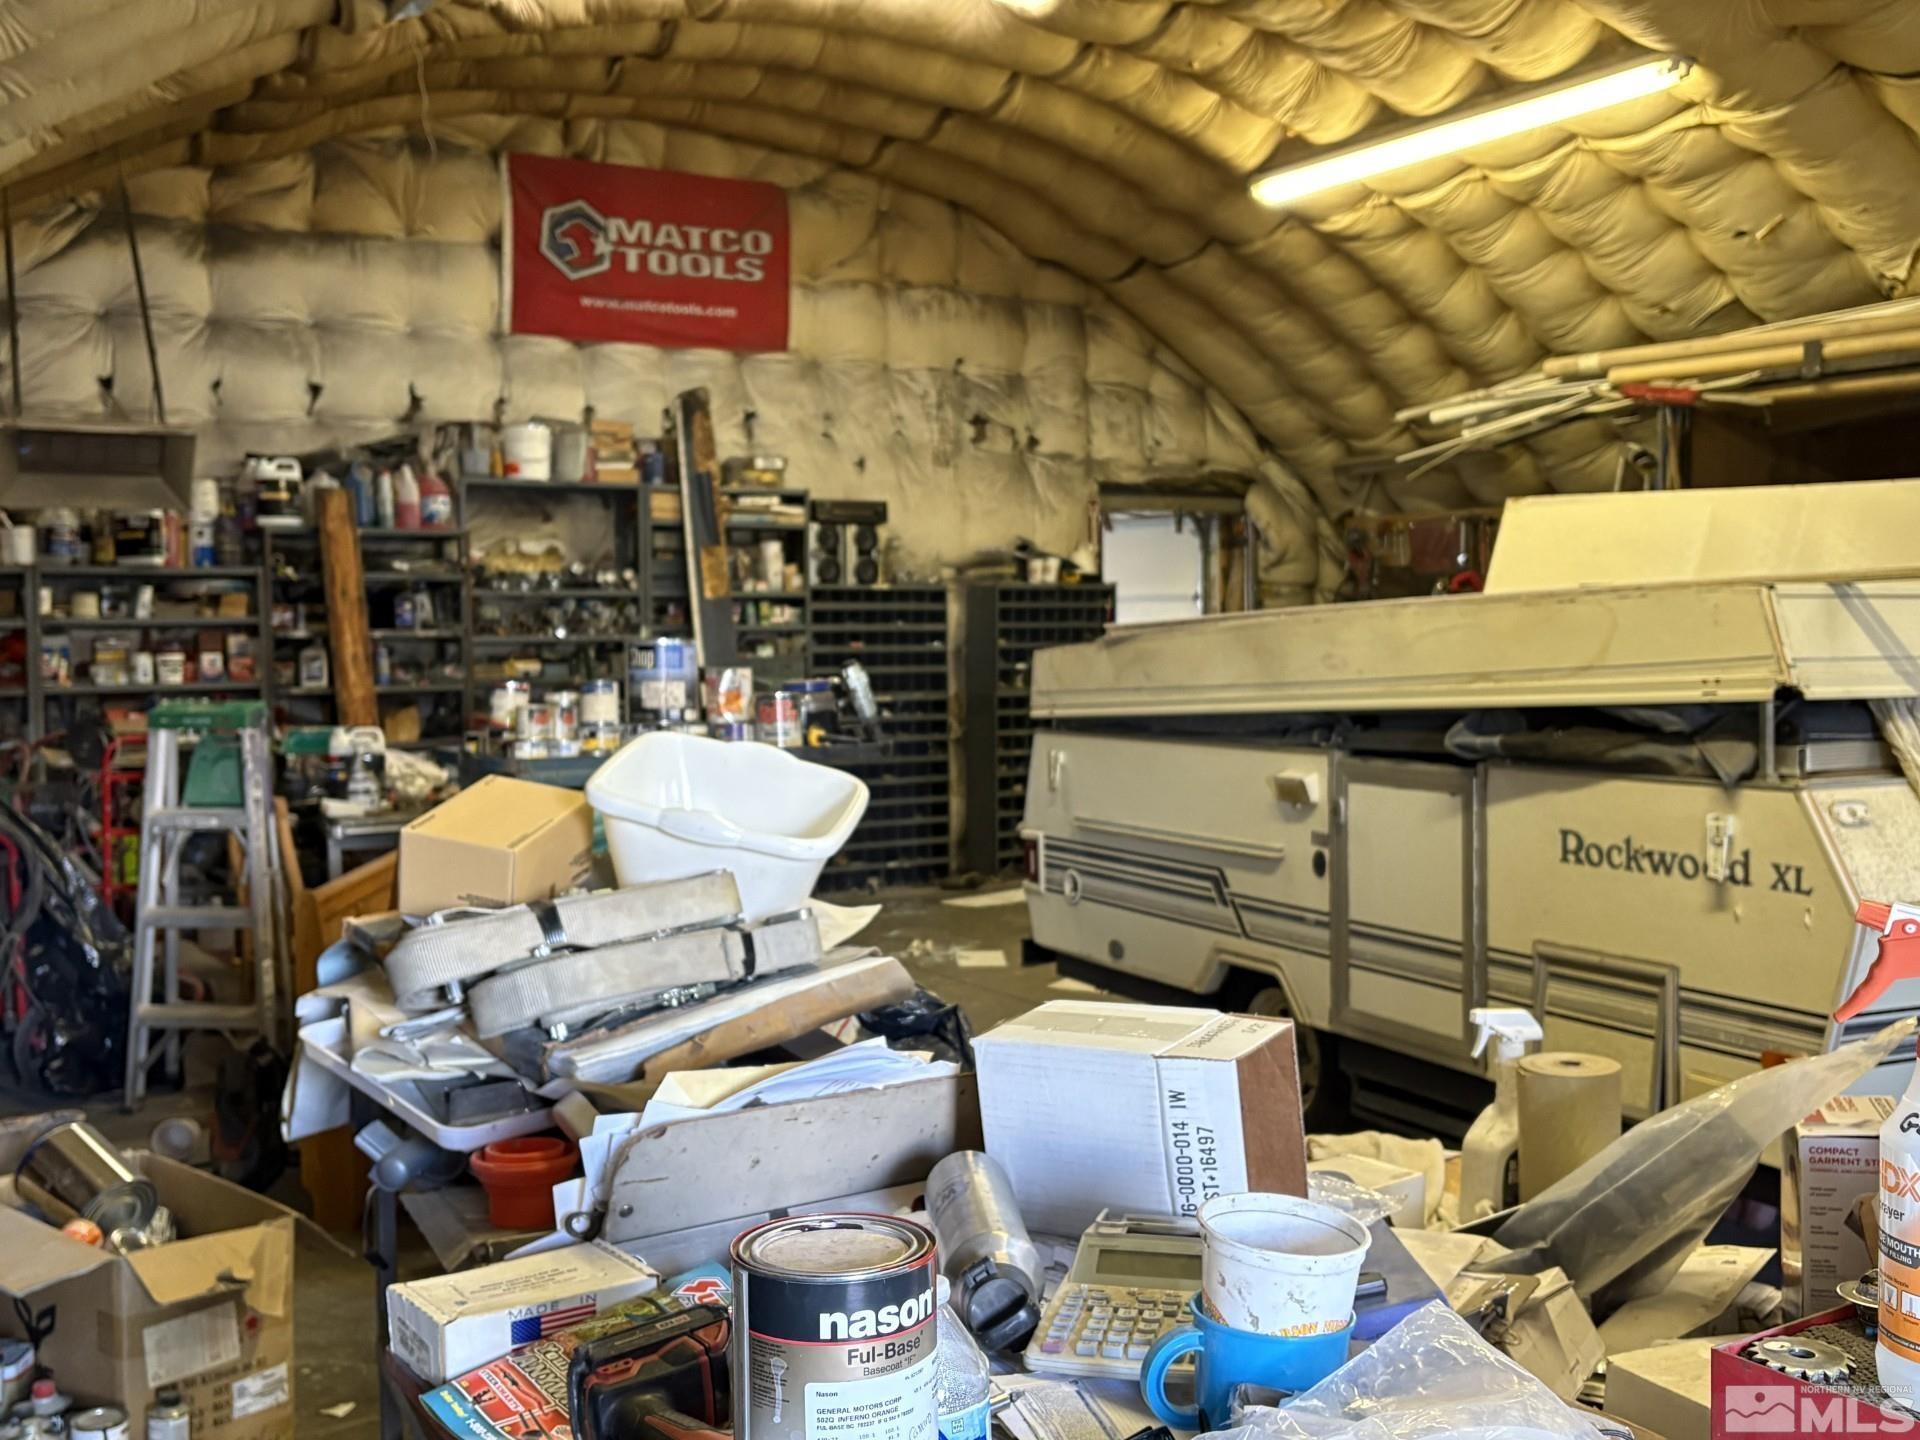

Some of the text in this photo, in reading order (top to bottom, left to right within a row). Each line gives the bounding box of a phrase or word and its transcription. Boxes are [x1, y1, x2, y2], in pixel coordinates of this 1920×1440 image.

[605, 216, 773, 255] MATCO
[616, 247, 765, 282] TOOLS
[1559, 828, 1813, 896] Rockwod XL
[1809, 1146, 1859, 1157] COMPACT
[1809, 1156, 1861, 1167] GARMENT
[1880, 1157, 1920, 1204] DX
[1887, 1233, 1920, 1259] MOUTH
[508, 1293, 597, 1320] MADE IN
[820, 1288, 933, 1340] nason
[847, 1335, 921, 1366] Ful-Base
[863, 1360, 903, 1377] Basecoat
[816, 1396, 902, 1415] GENERAL MOTORS CORP
[837, 1413, 870, 1423] INFERNO
[871, 1406, 899, 1418] ORANGE
